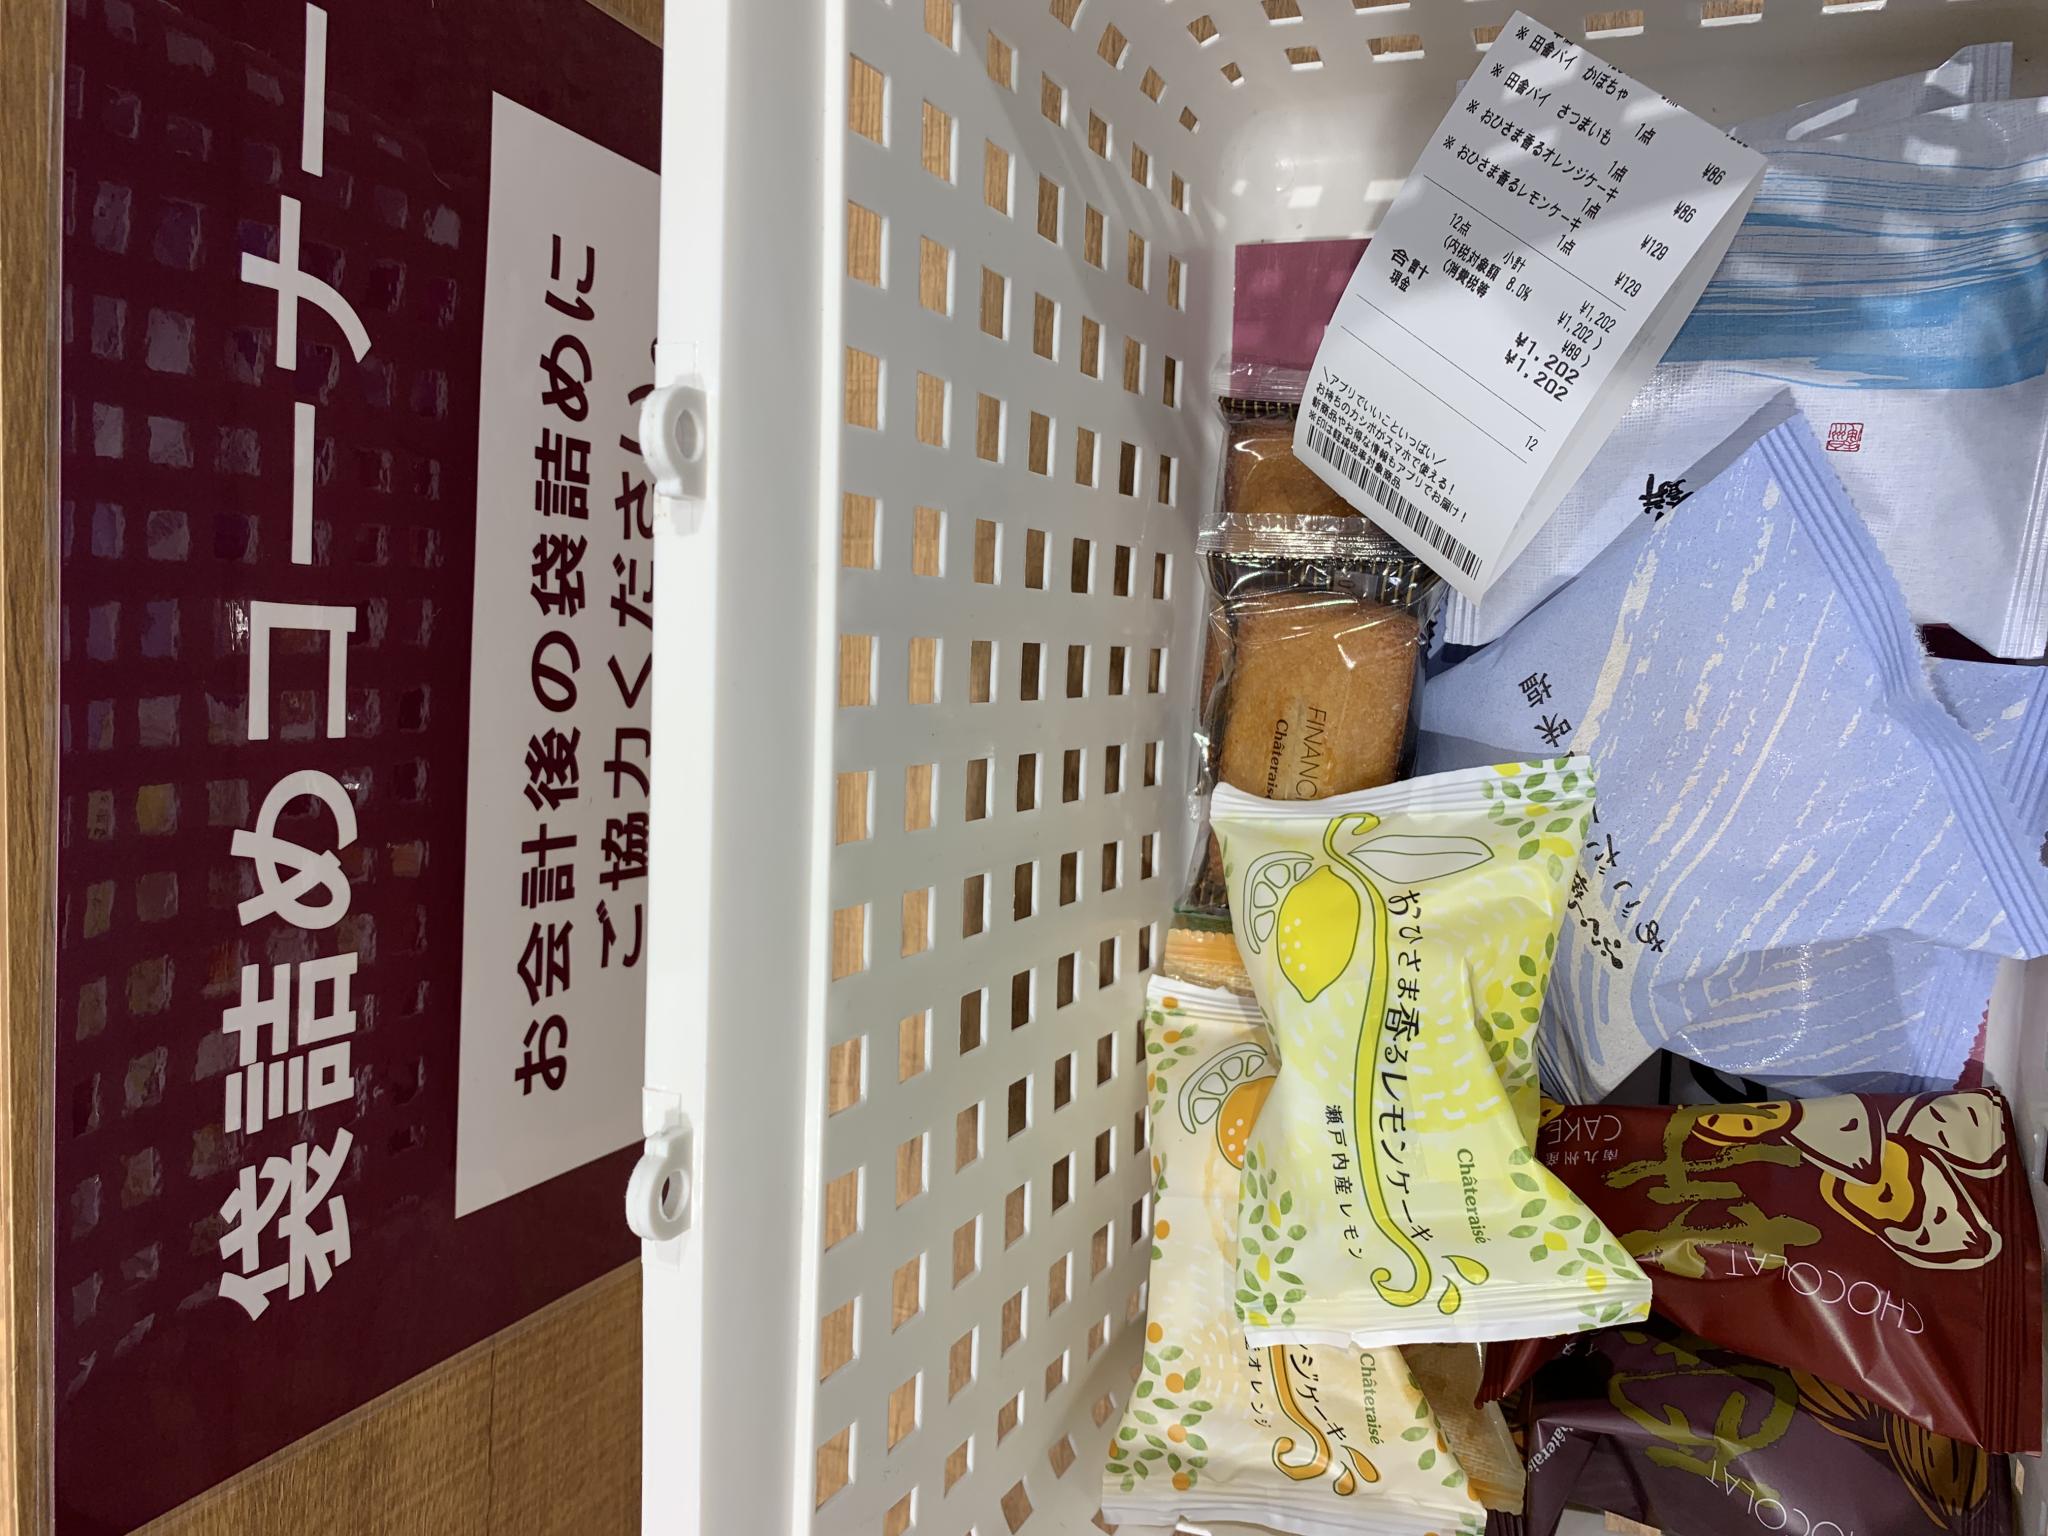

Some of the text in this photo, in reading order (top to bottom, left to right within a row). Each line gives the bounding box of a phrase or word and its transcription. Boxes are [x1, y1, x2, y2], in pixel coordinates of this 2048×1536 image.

[1556, 103, 1612, 146] さつまいも
[1580, 65, 1629, 102] かぼちゃ
[1456, 143, 1583, 233] おひさま香るレモンケーキ
[1479, 107, 1620, 204] おひさま香るオレンジケーキ
[1607, 160, 1697, 224] 1点 ¥86
[1634, 121, 1727, 186] 1点 ¥86
[1448, 212, 1617, 334] 12点 小計 ¥1,202
[1556, 233, 1642, 298] 1点 ¥129
[1580, 197, 1669, 262] 1点 ¥129
[1388, 268, 1569, 403] 現金 ¥1,202
[1390, 248, 1580, 386] 合計 ¥1,202
[1524, 435, 1539, 452] 12
[218, 2, 371, 1321] 袋詰めコーナー
[514, 233, 597, 1096] お会計後の袋詰めに
[1295, 706, 1327, 801] FINANC
[1378, 888, 1434, 1242] おひさま香るレモンケーキ
[1550, 1113, 1622, 1145] CAKE
[1324, 1104, 1363, 1260] 瀬戸内産レモン
[1456, 1147, 1492, 1245] Châteraisé
[1725, 1244, 1924, 1335] CHOCOLAT
[1289, 1343, 1347, 1441] ジケーキ
[1359, 1352, 1385, 1446] Châteraisé
